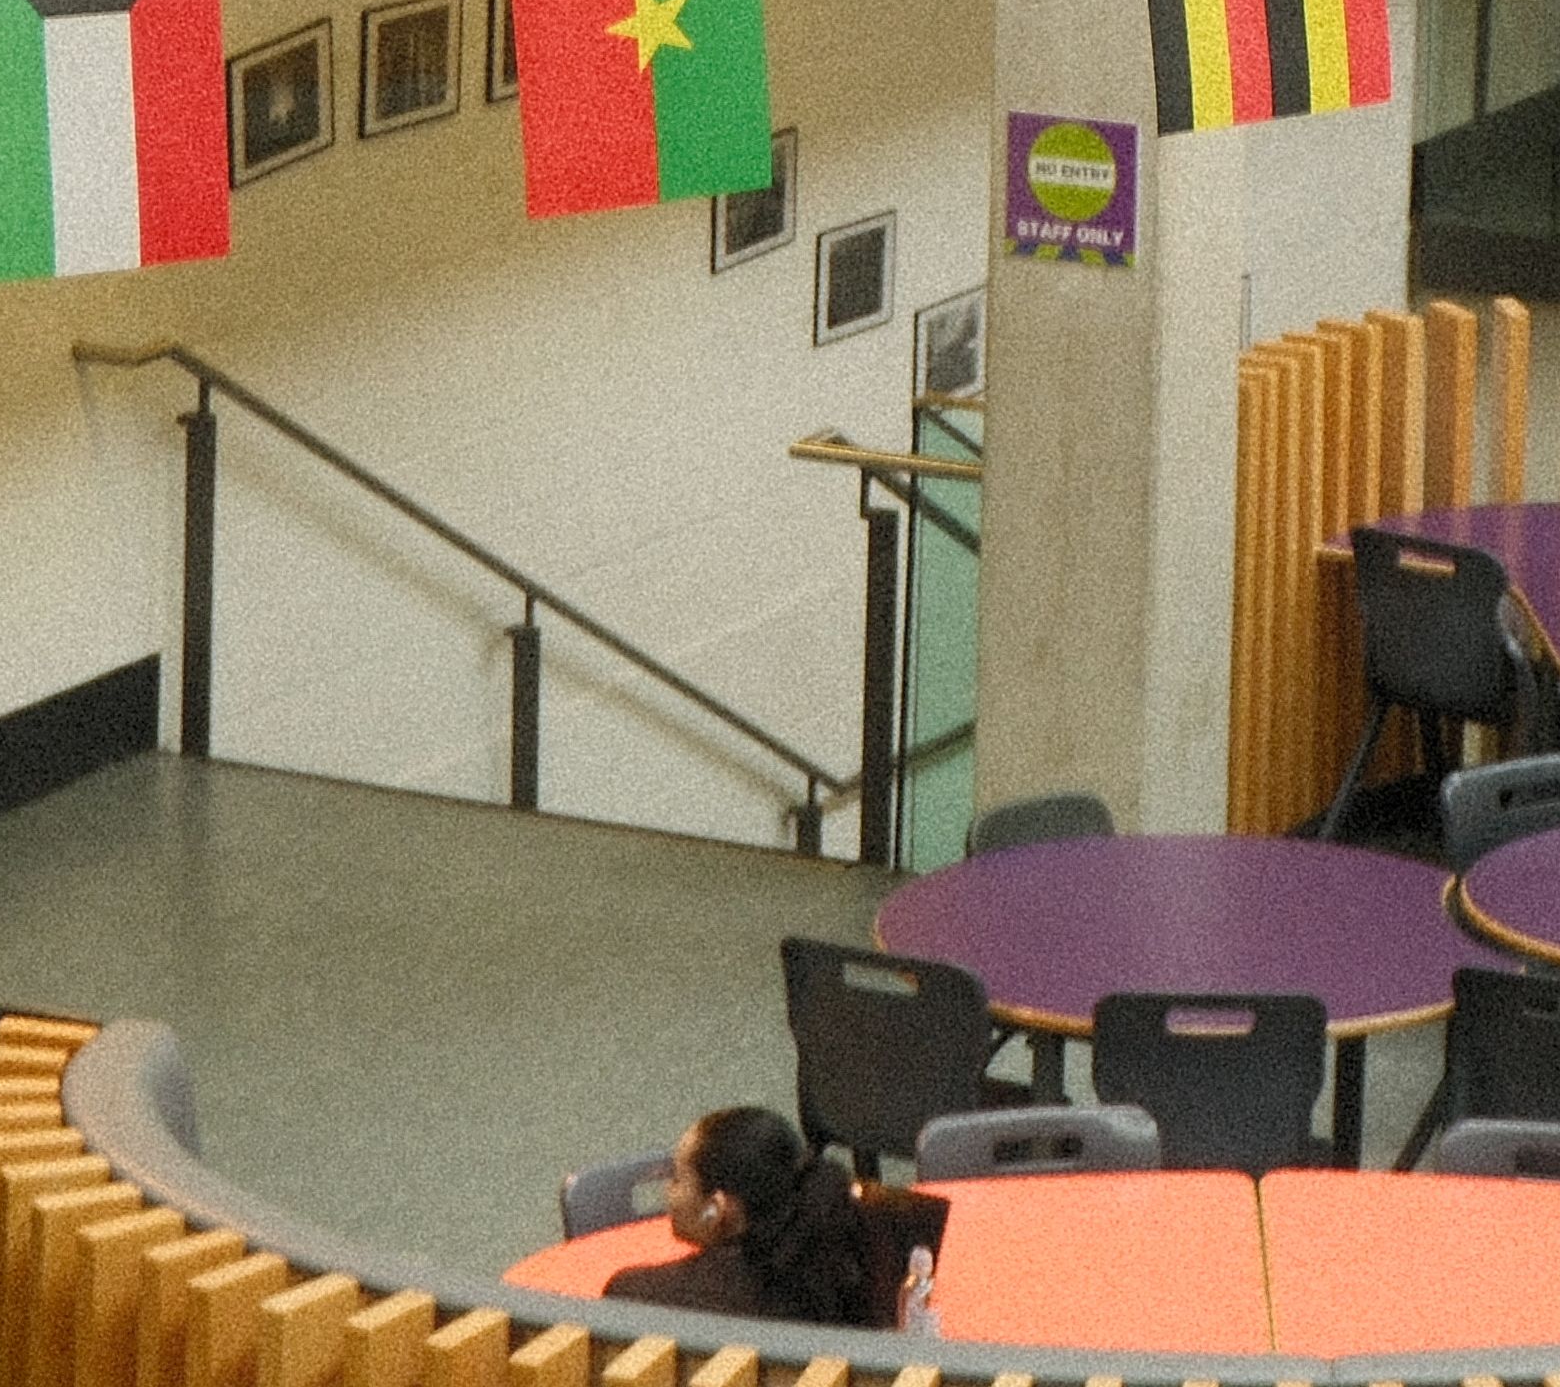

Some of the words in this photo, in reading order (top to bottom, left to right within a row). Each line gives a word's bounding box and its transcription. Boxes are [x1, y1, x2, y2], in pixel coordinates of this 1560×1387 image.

[1036, 161, 1057, 176] NO
[1061, 165, 1109, 179] ENTRY
[1017, 220, 1073, 241] STAFF
[1076, 227, 1124, 247] ONLY
